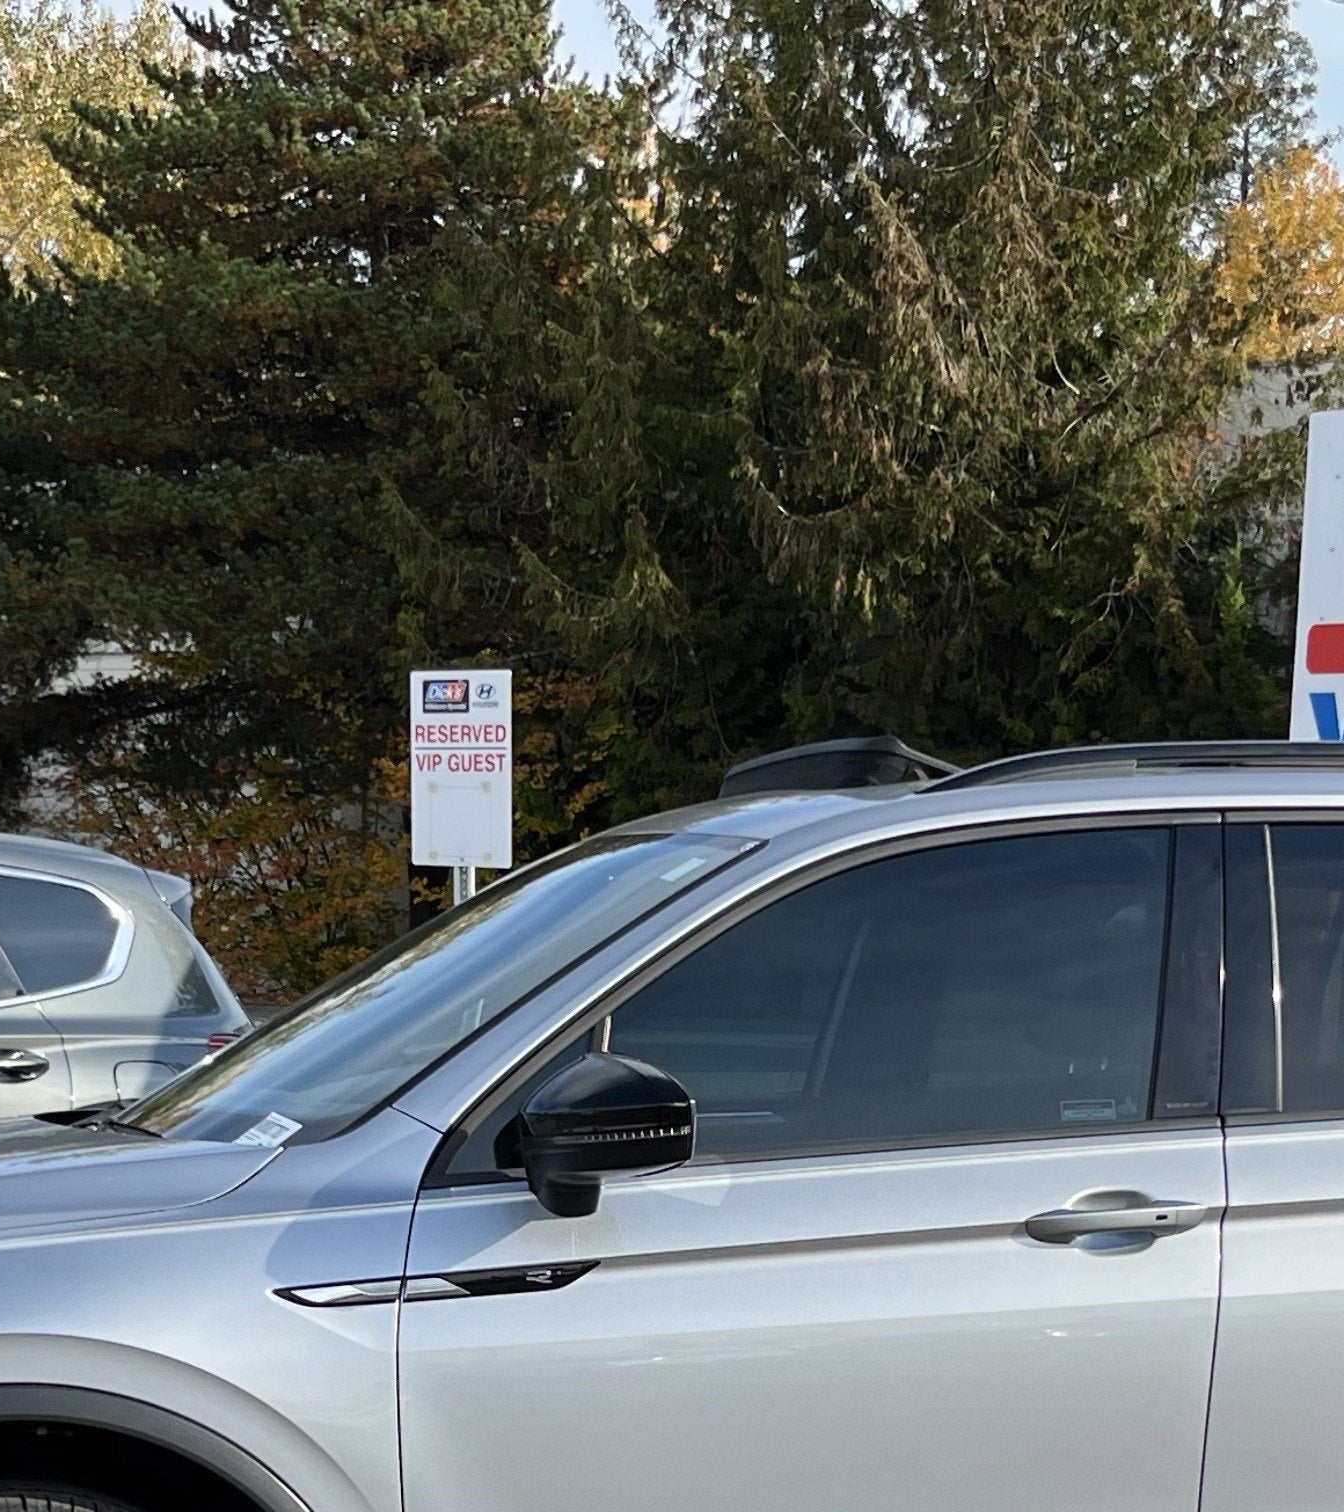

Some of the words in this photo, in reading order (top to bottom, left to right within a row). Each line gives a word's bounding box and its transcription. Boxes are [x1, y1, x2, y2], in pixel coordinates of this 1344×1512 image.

[414, 724, 507, 743] RESERVED
[415, 754, 443, 772] VIP
[447, 753, 507, 773] GUEST
